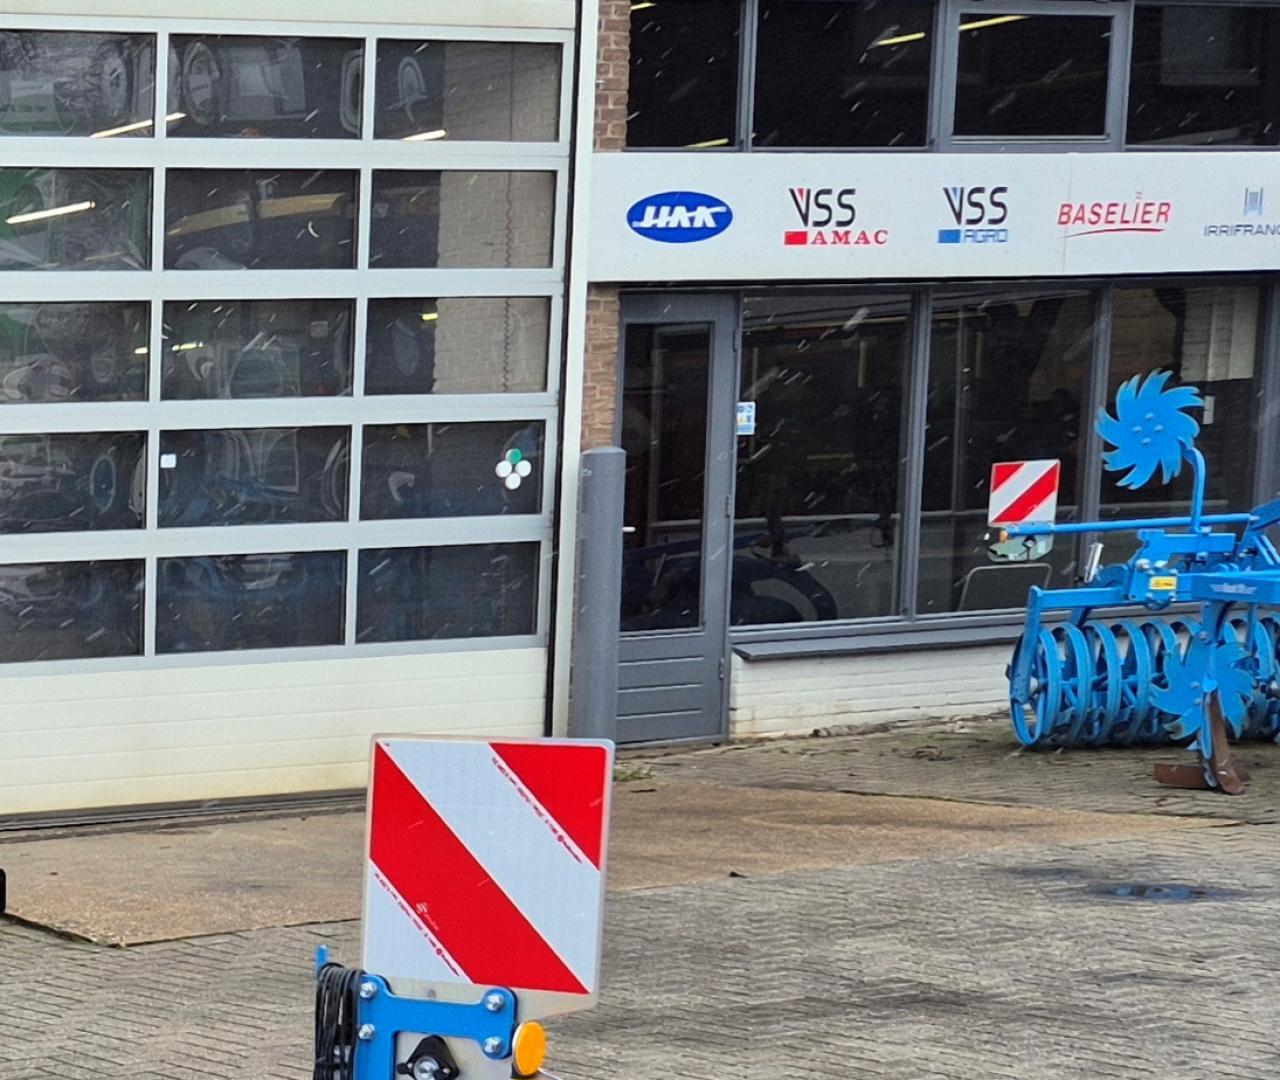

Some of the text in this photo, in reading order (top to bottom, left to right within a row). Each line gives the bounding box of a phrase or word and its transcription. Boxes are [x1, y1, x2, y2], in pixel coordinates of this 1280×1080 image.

[788, 188, 856, 227] VSS
[942, 186, 1008, 225] VSS
[1057, 202, 1171, 225] BASELIER
[810, 229, 889, 245] AMAC
[963, 229, 1008, 243] AGRO
